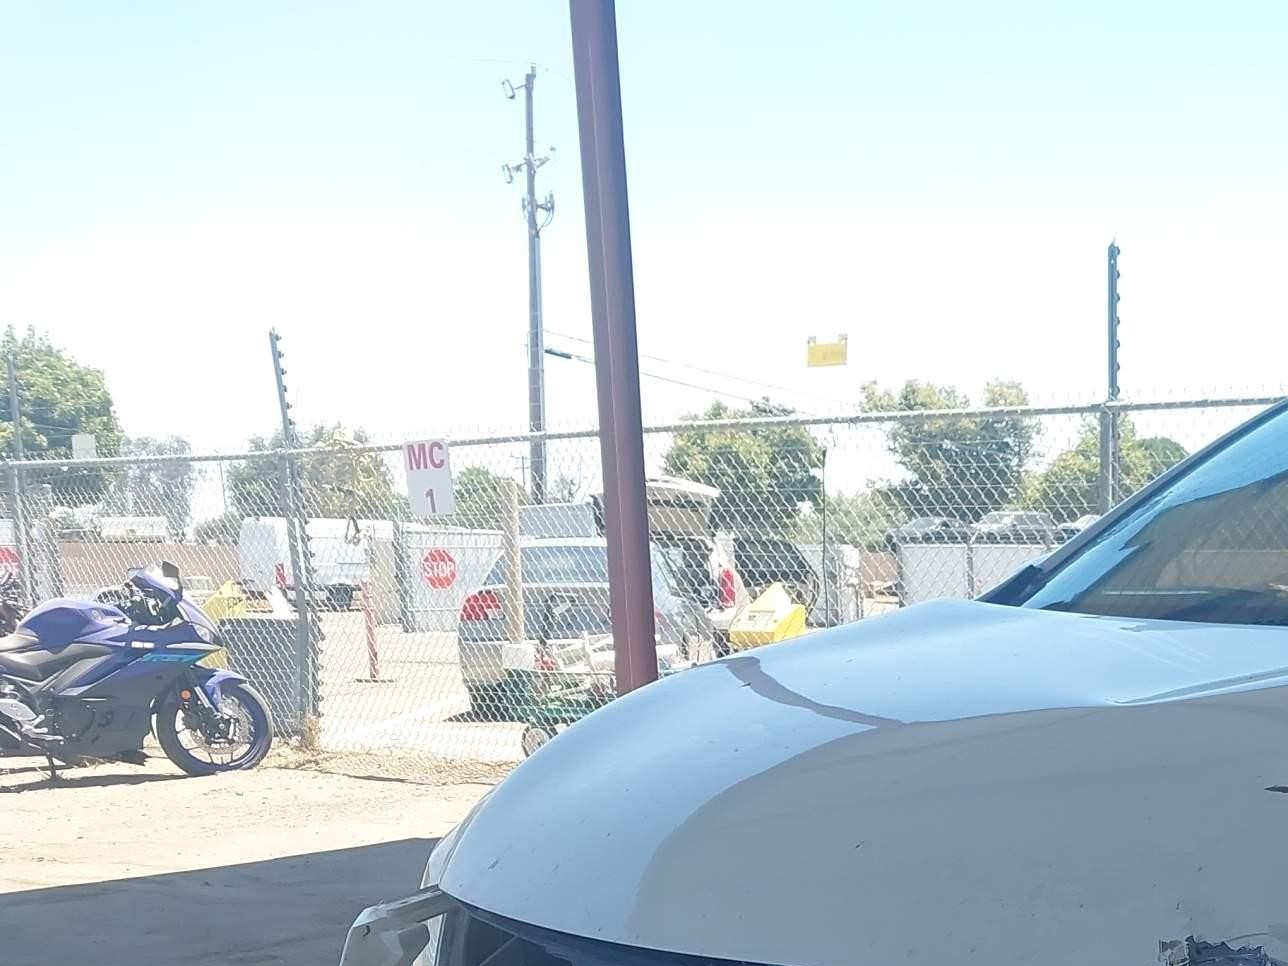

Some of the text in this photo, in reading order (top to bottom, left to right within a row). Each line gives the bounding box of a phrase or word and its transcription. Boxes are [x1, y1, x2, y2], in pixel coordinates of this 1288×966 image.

[407, 441, 445, 470] MC
[425, 488, 437, 514] 1
[424, 561, 454, 577] STOP
